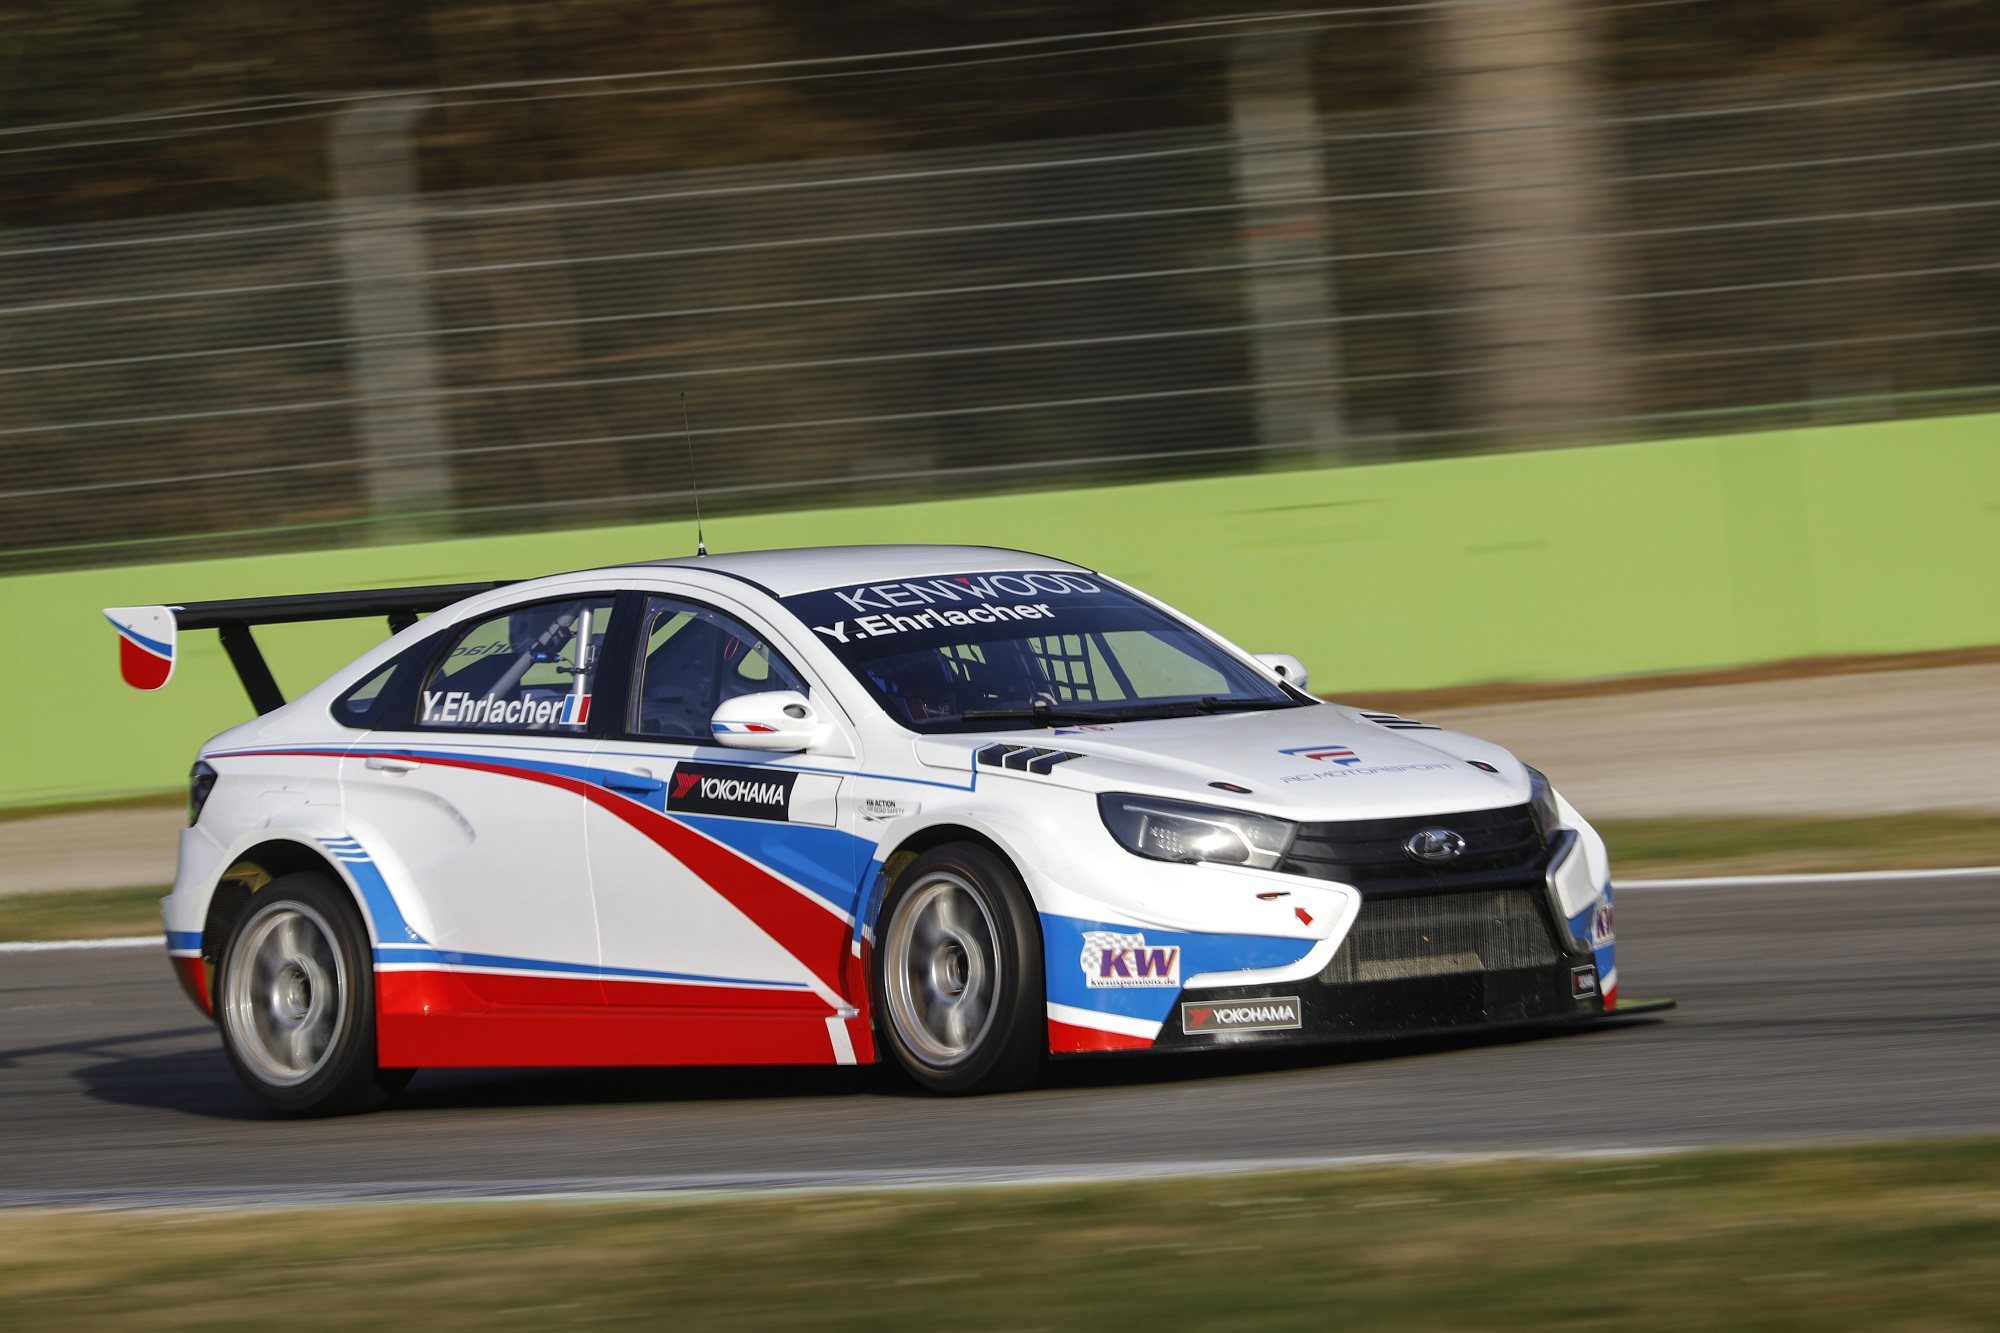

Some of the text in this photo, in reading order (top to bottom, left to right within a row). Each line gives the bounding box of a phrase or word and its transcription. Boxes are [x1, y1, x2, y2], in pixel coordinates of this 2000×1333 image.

[834, 574, 1100, 612] KENWOOD
[813, 602, 1055, 644] Y.Ehrlacher
[423, 691, 563, 723] Y.Ehrlacher
[1313, 763, 1453, 780] MOTORSPORT
[701, 777, 784, 805] YOKOHAMA
[1100, 948, 1178, 978] KW
[1212, 1005, 1296, 1024] YOKOHAMA
